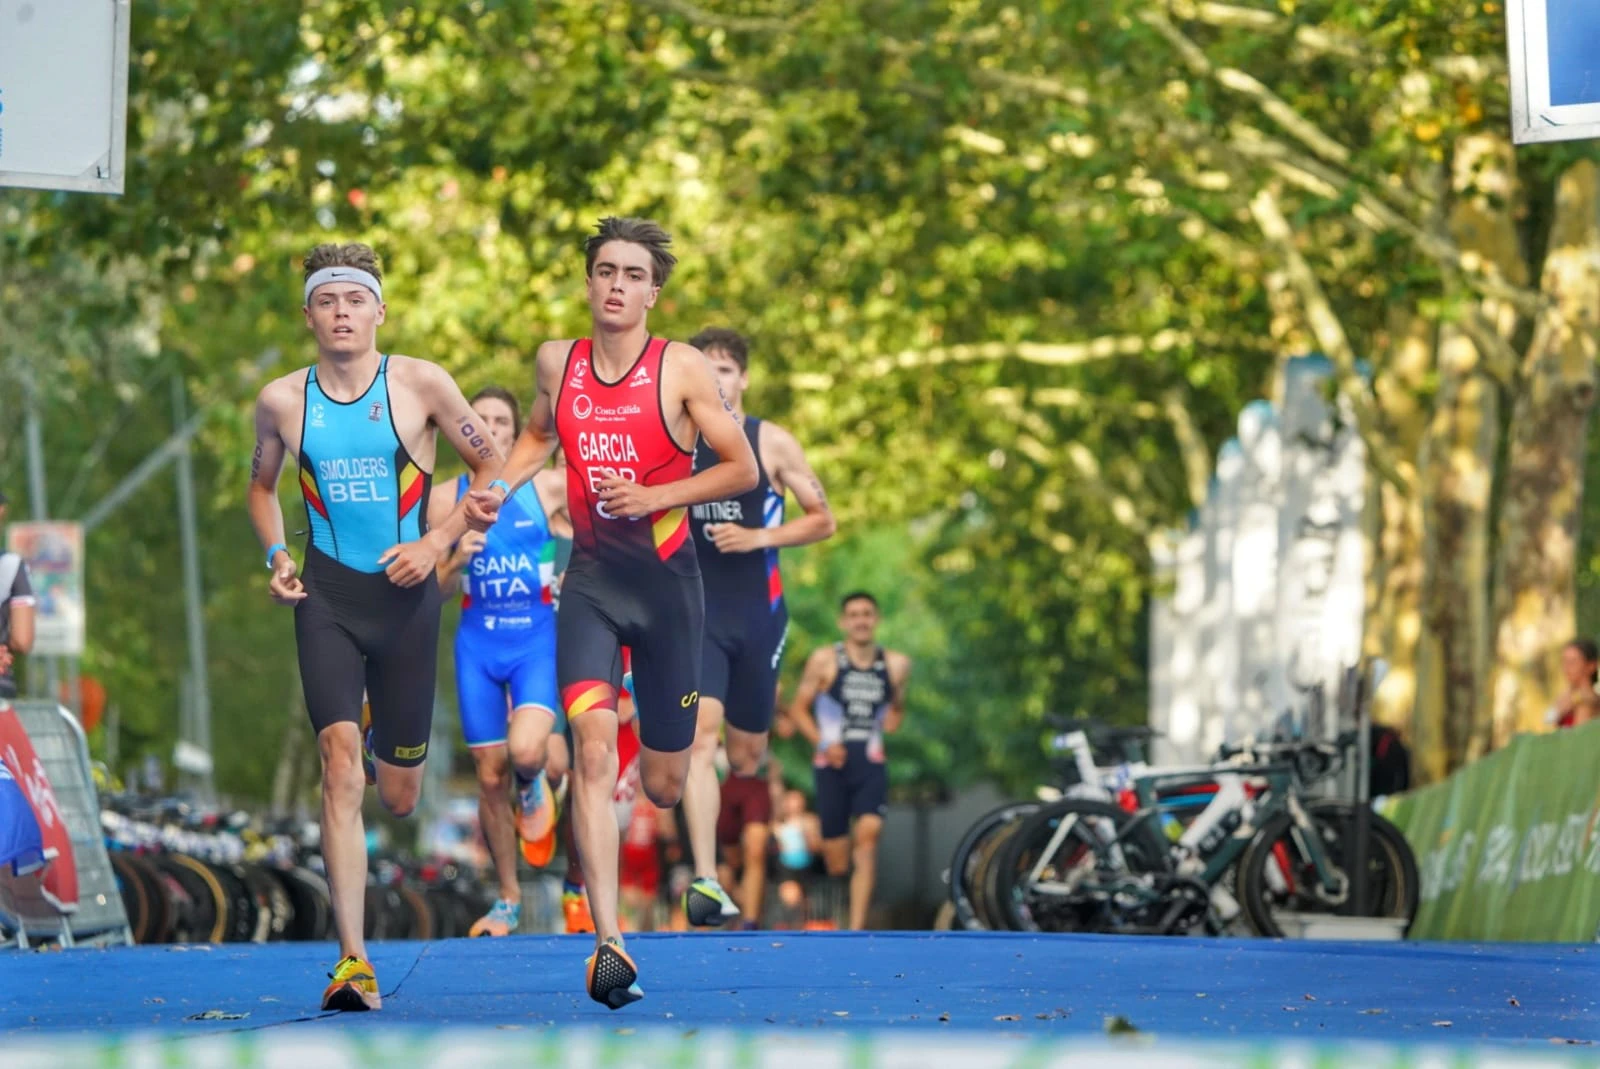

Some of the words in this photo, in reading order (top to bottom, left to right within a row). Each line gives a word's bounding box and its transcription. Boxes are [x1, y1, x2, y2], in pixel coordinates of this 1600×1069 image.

[578, 432, 640, 462] GARCIA
[319, 457, 389, 480] SMOLDERS
[327, 480, 390, 503] BEL
[473, 553, 533, 577] SANA
[480, 576, 531, 598] ITA
